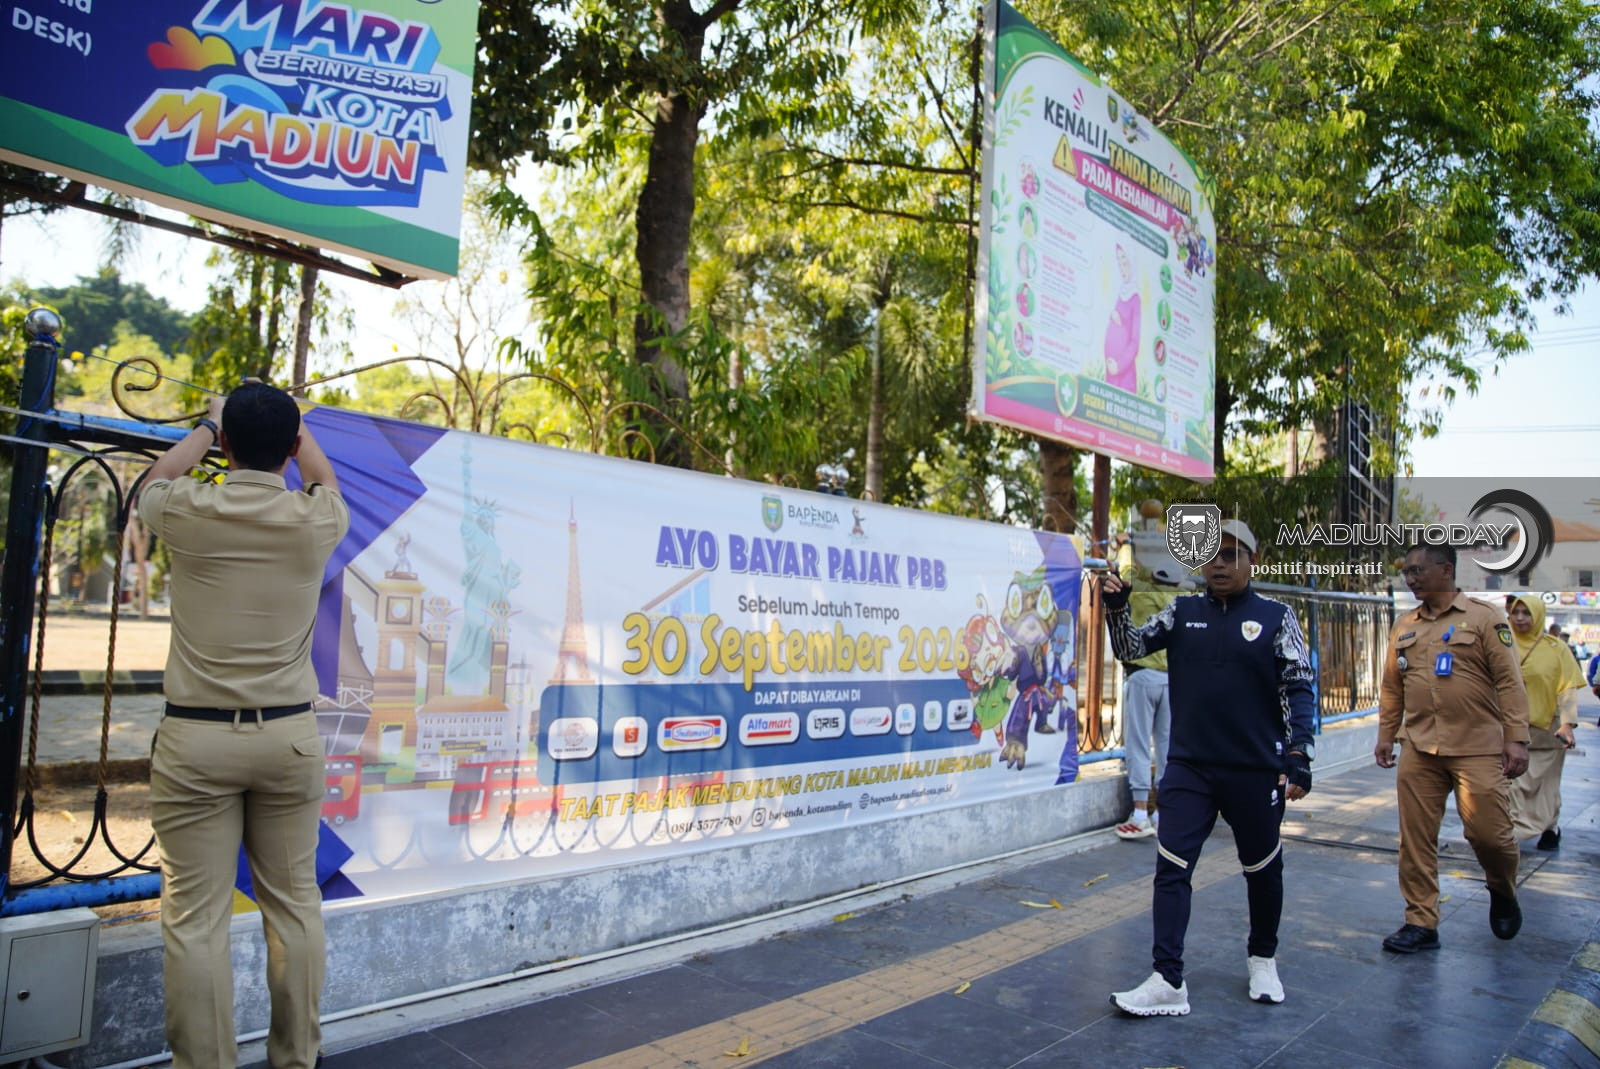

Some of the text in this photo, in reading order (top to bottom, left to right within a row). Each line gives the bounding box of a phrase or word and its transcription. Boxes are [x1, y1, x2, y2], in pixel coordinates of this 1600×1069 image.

[12, 7, 92, 56] DESK)
[195, 0, 430, 72] MARI
[256, 53, 442, 97] BERINVESTASI
[127, 88, 424, 184] MADIUN
[303, 84, 435, 145] KOTA
[1082, 157, 1112, 193] PADA
[1115, 176, 1168, 224] KEHAMILAN
[1108, 139, 1149, 189] TANDA
[1150, 166, 1192, 216] BAHAYA
[788, 504, 840, 526] BAPENDA
[655, 526, 948, 591] AYO BAYAR PAJAK PBB
[738, 594, 900, 625] Sebelum Jatuh Tempo
[622, 612, 971, 692] 30 September 2026
[747, 717, 792, 731] Alfamart
[754, 688, 861, 705] DAPAT DIBAYARKAN DI
[814, 716, 839, 732] QRIS
[558, 752, 993, 822] TAAT PAJAK MENDUKUNG KOTA MADIUN MAJU MENDUNIA
